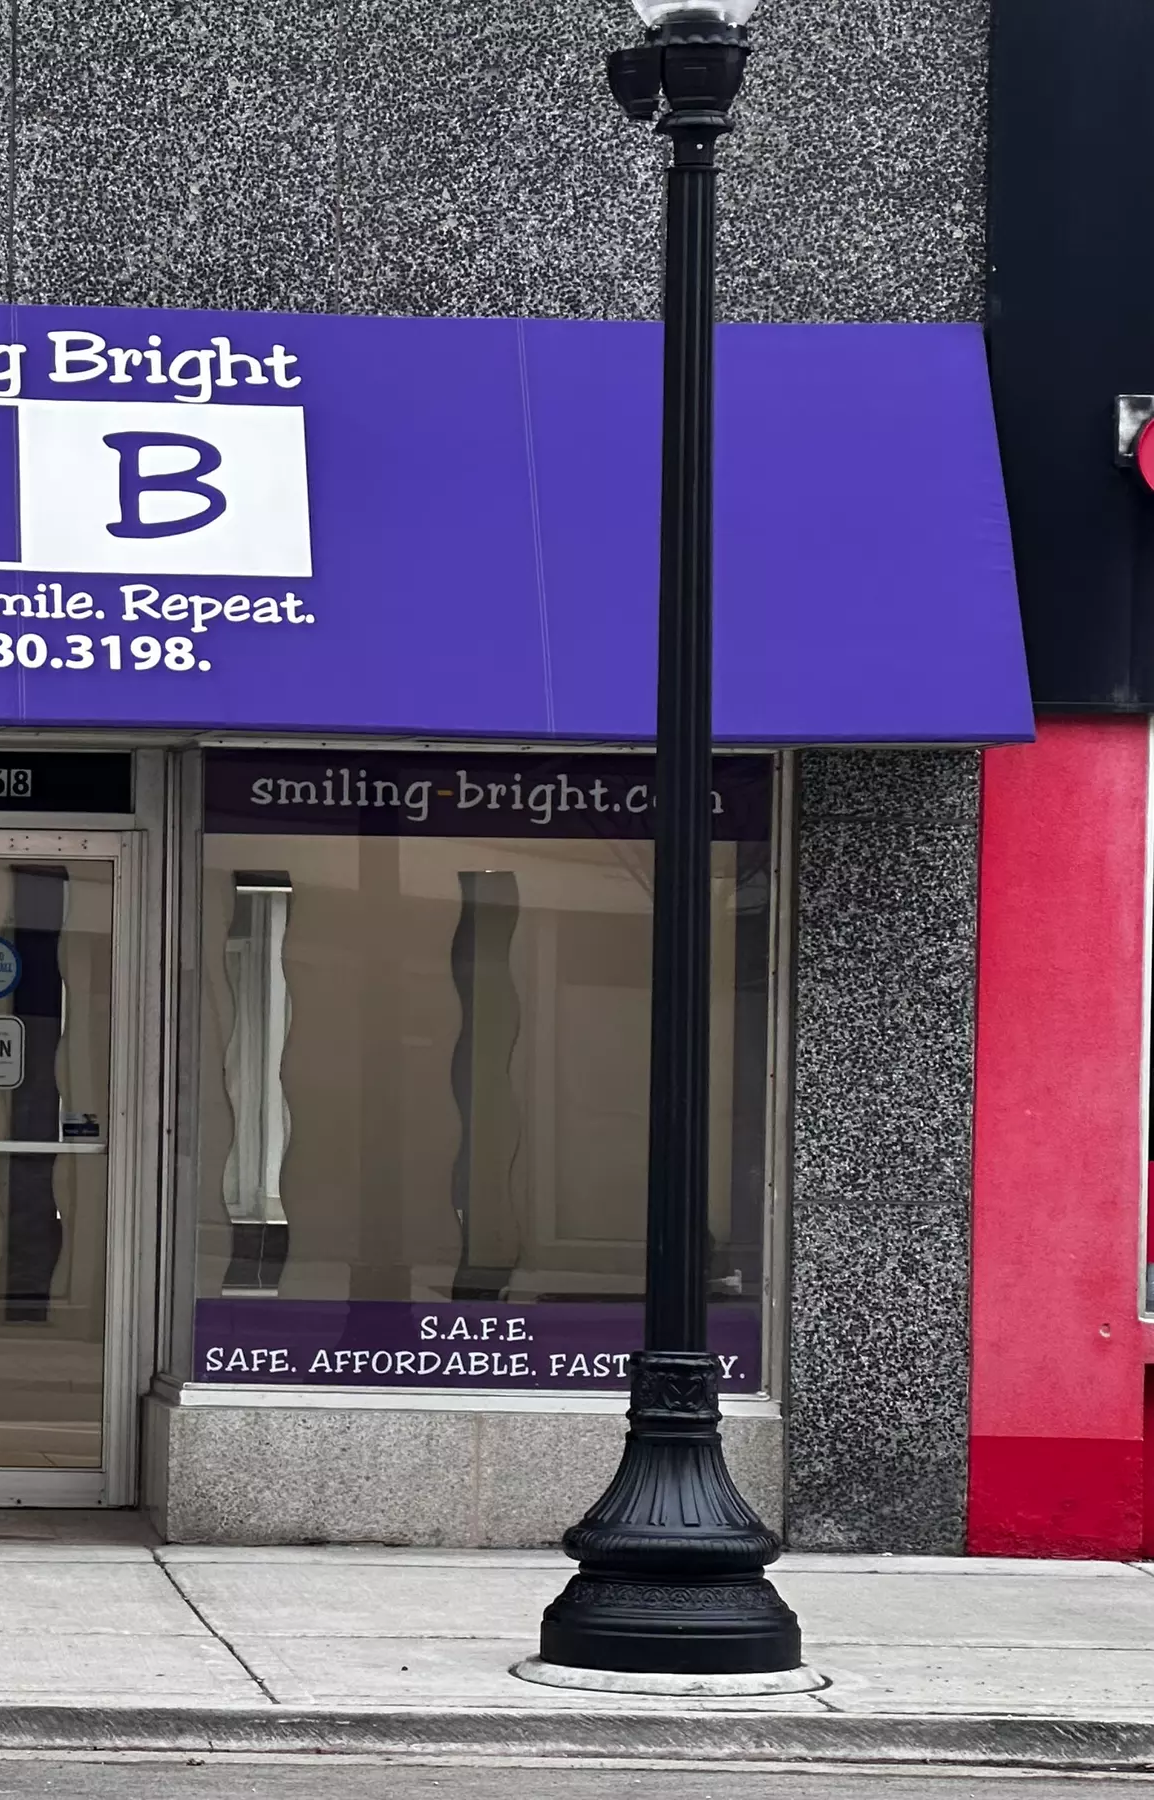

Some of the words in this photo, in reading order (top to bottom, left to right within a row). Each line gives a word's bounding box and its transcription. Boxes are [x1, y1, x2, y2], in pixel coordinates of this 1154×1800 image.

[47, 331, 302, 403] Bright
[102, 431, 227, 539] B
[121, 584, 315, 633] Repeat.
[251, 769, 725, 824] smiling-bright.c
[420, 1315, 534, 1342] S.A.F.E.
[206, 1347, 297, 1373] SAFE.
[309, 1349, 537, 1377] AFFORDABLE.
